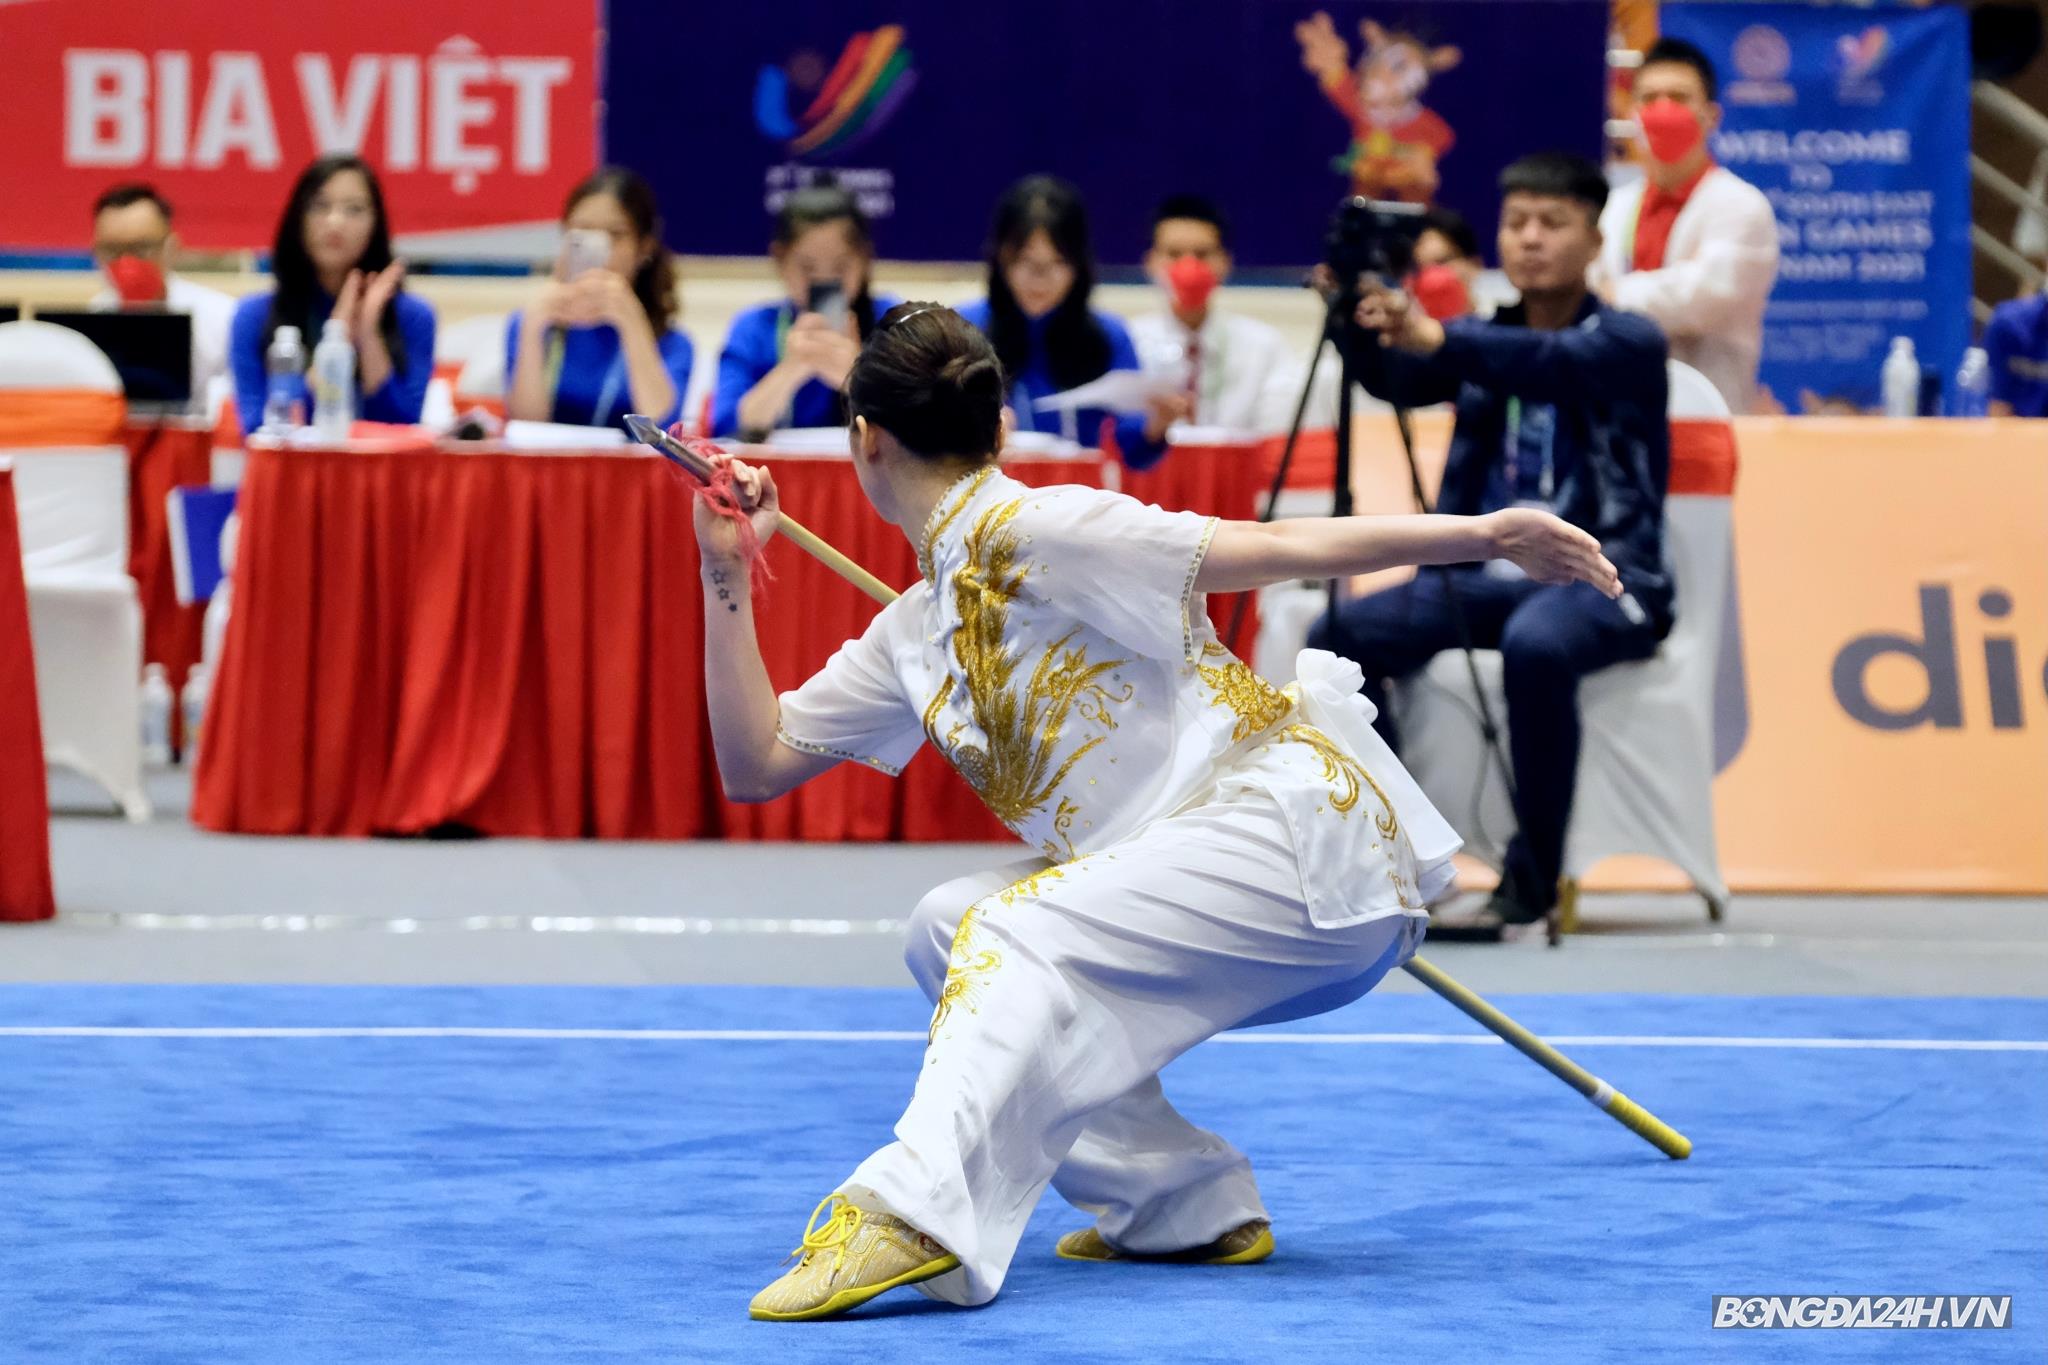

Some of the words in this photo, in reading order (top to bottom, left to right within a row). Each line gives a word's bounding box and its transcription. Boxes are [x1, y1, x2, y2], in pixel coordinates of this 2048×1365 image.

[64, 48, 281, 170] BIA
[294, 34, 572, 194] VIỆT
[1713, 130, 1910, 164] WELCOME
[1791, 163, 1833, 190] TO
[1804, 218, 1932, 249] GAMES
[1831, 583, 2048, 732] di
